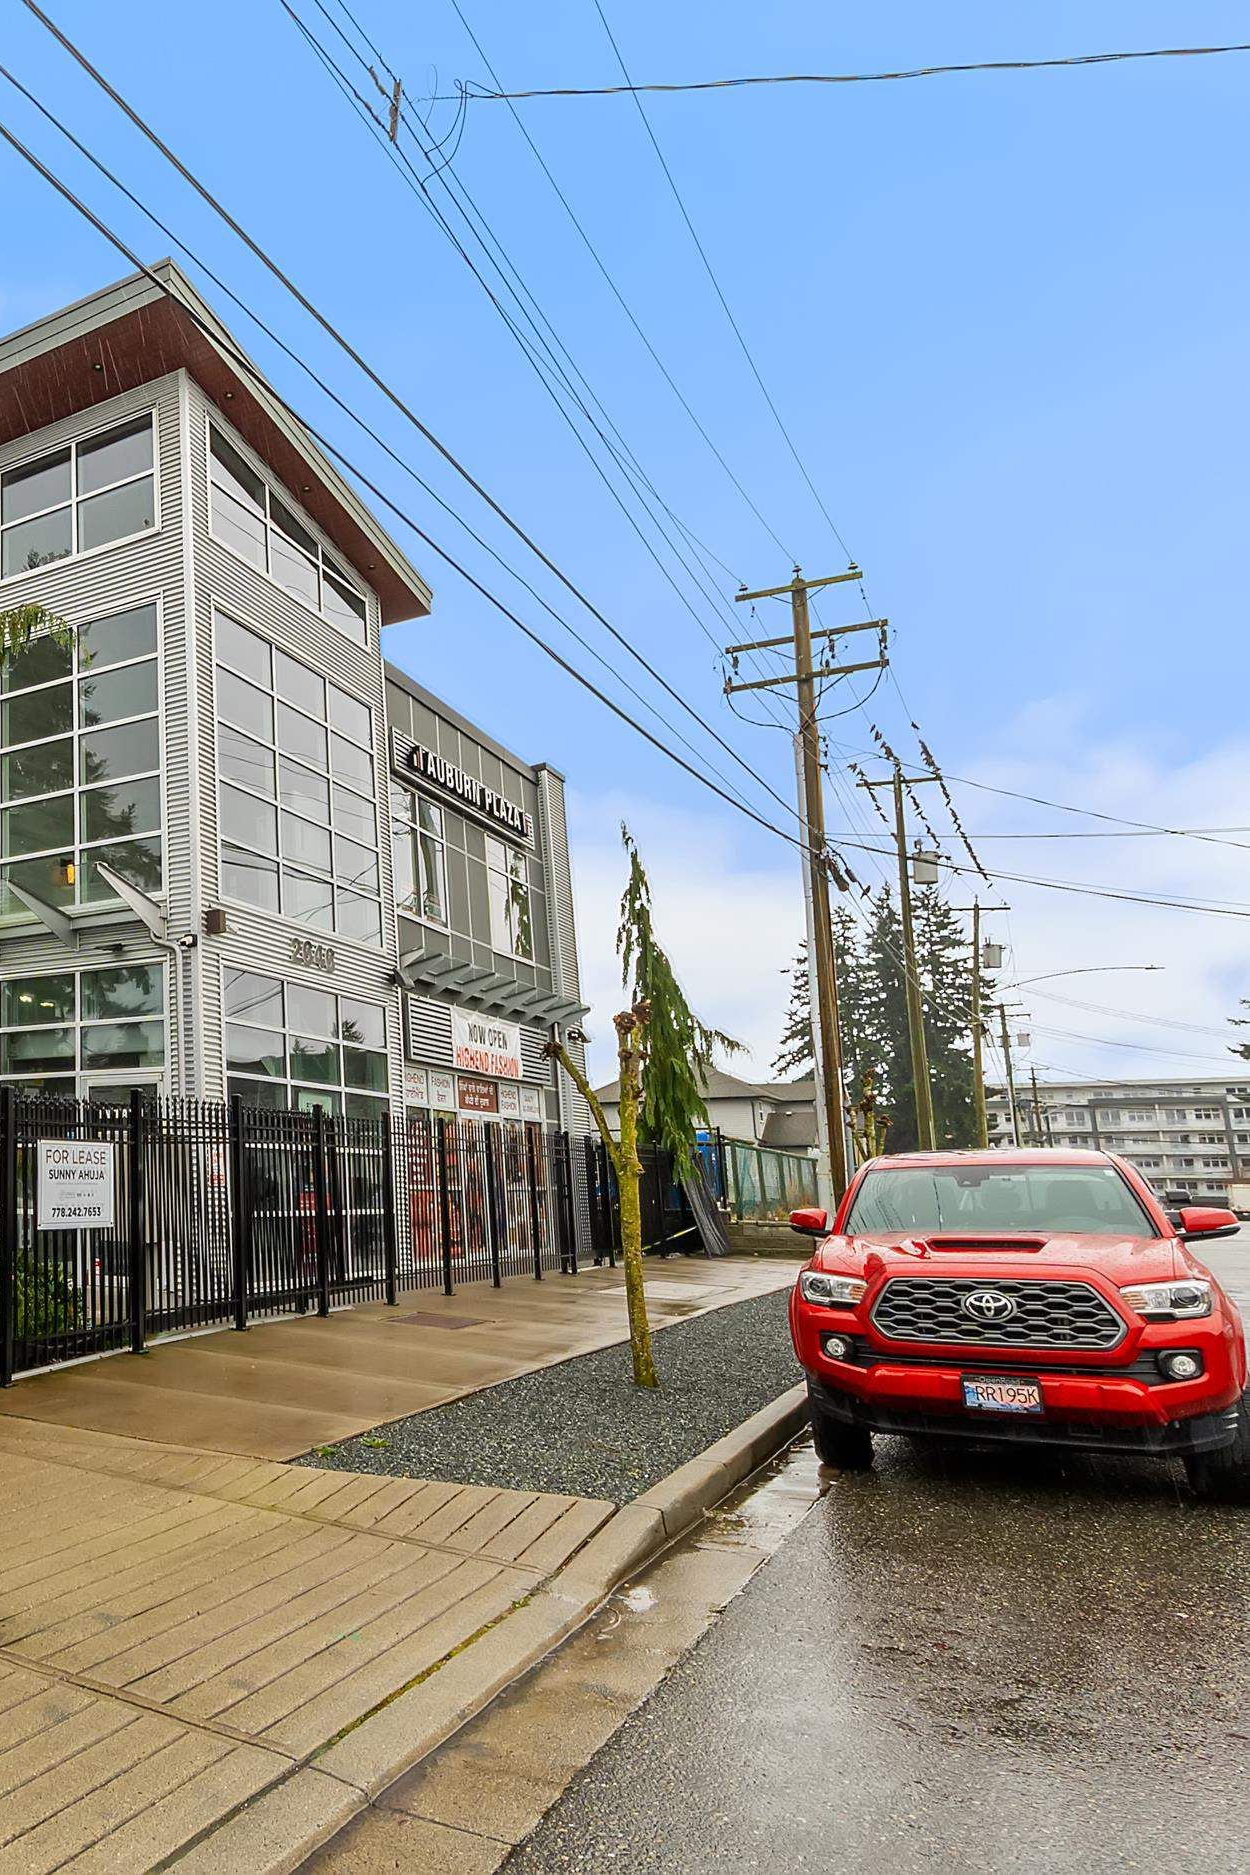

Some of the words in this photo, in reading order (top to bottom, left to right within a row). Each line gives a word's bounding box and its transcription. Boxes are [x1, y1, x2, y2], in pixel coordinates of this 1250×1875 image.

[427, 751, 482, 807] AUBURN
[485, 788, 522, 832] PLAZA
[467, 1022, 486, 1045] NOW
[488, 1028, 508, 1050] OPEN
[456, 1045, 489, 1072] HIGHEND
[490, 1053, 519, 1078] FASHION
[46, 1149, 69, 1164] FOR
[72, 1150, 107, 1165] LEASE
[48, 1169, 77, 1180] SUNNY
[78, 1169, 105, 1180] AHUJA
[51, 1206, 102, 1218] 778.242.7653
[975, 1385, 1039, 1404] RR195K
